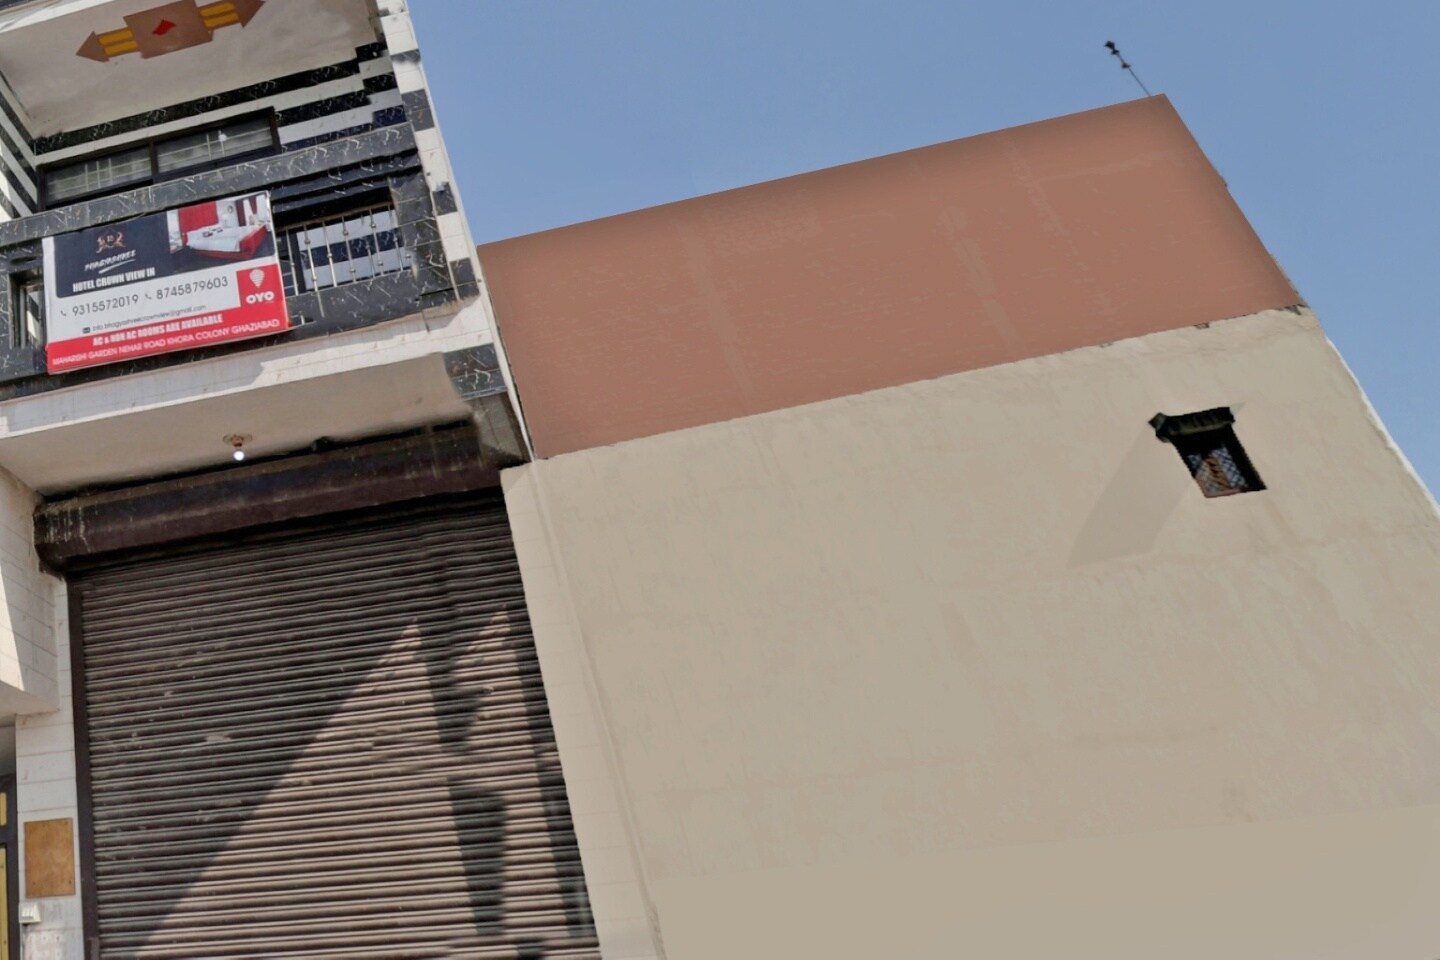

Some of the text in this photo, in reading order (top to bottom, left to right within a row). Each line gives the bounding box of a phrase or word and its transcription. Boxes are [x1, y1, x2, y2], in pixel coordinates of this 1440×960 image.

[72, 266, 156, 293] HOTEL CROWN VIEW IN
[71, 276, 229, 317] 9315572019 8745879603
[246, 290, 275, 304] OYO
[88, 347, 118, 360] GARDEN
[143, 338, 166, 351] ROAD
[195, 326, 230, 341] COLONY
[230, 318, 281, 335] GHAZIABAD
[137, 324, 165, 339] ROOMS
[165, 321, 180, 333] ARE
[180, 313, 224, 331] AVAILABLE
